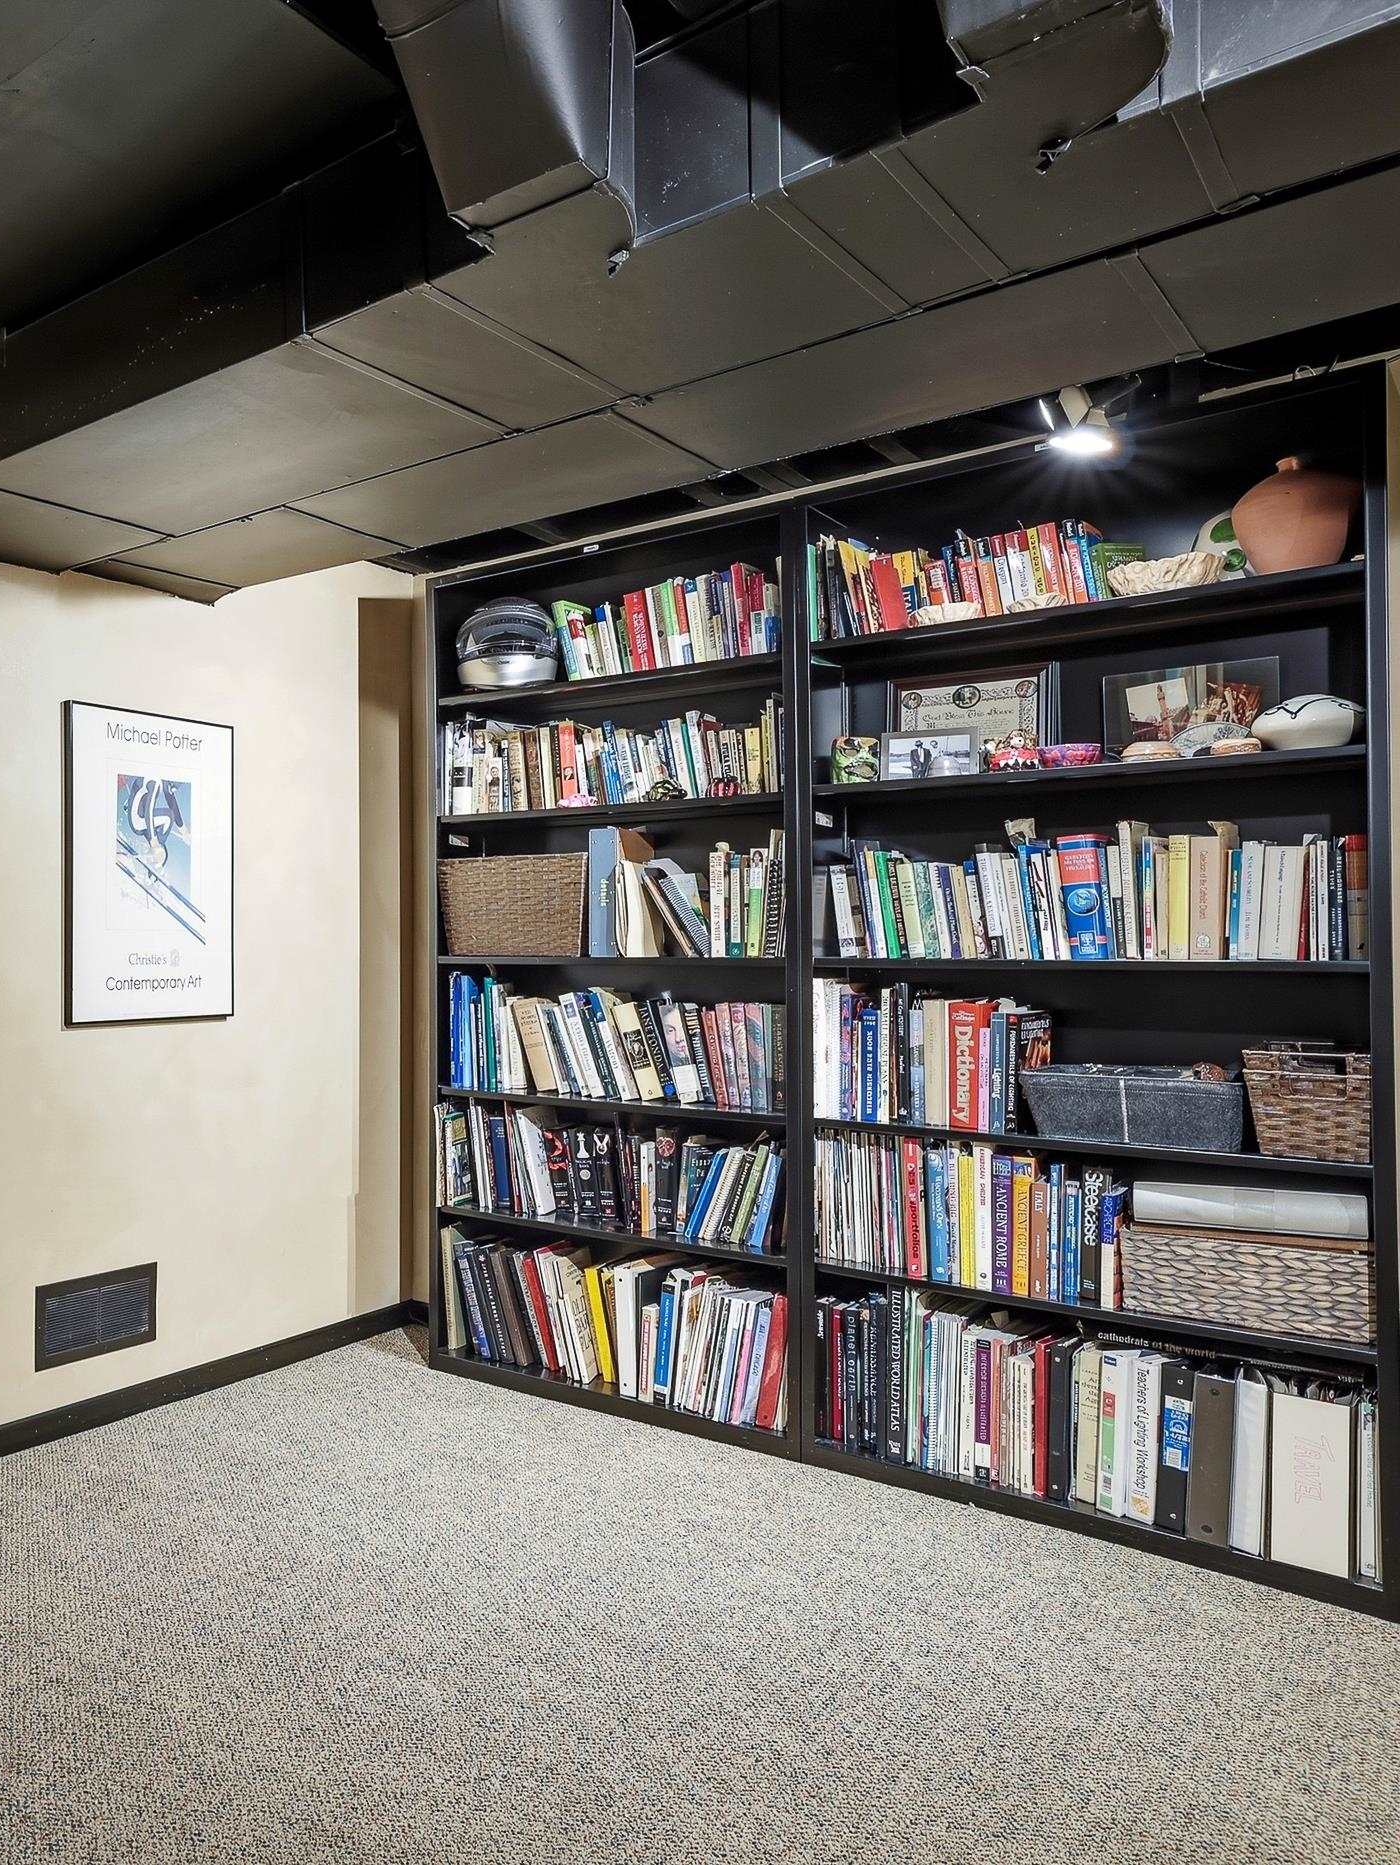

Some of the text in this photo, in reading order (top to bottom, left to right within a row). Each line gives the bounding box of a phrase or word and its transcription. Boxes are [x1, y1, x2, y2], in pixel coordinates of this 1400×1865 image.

[106, 722, 203, 752] Michael Potter
[598, 878, 609, 907] details
[105, 975, 202, 993] Contemporary Art
[128, 951, 168, 968] Christie's
[639, 1007, 664, 1069] JANE FONDA
[952, 1025, 975, 1123] Dictionary
[992, 1068, 1002, 1098] Lighting
[995, 1187, 1007, 1268] ANCIENT ROME
[1016, 1190, 1027, 1272] ANCIENT GREECE
[1084, 1170, 1104, 1246] Steelcase
[847, 1316, 856, 1391] planet earth
[890, 1290, 901, 1432] ILLUSTRATED WORLD ATLAS
[1097, 1330, 1149, 1348] cathedrals
[1184, 1346, 1216, 1360] world
[1133, 1368, 1150, 1489] Teachers of Lighting Workshop
[1293, 1435, 1336, 1504] TRAVEL
